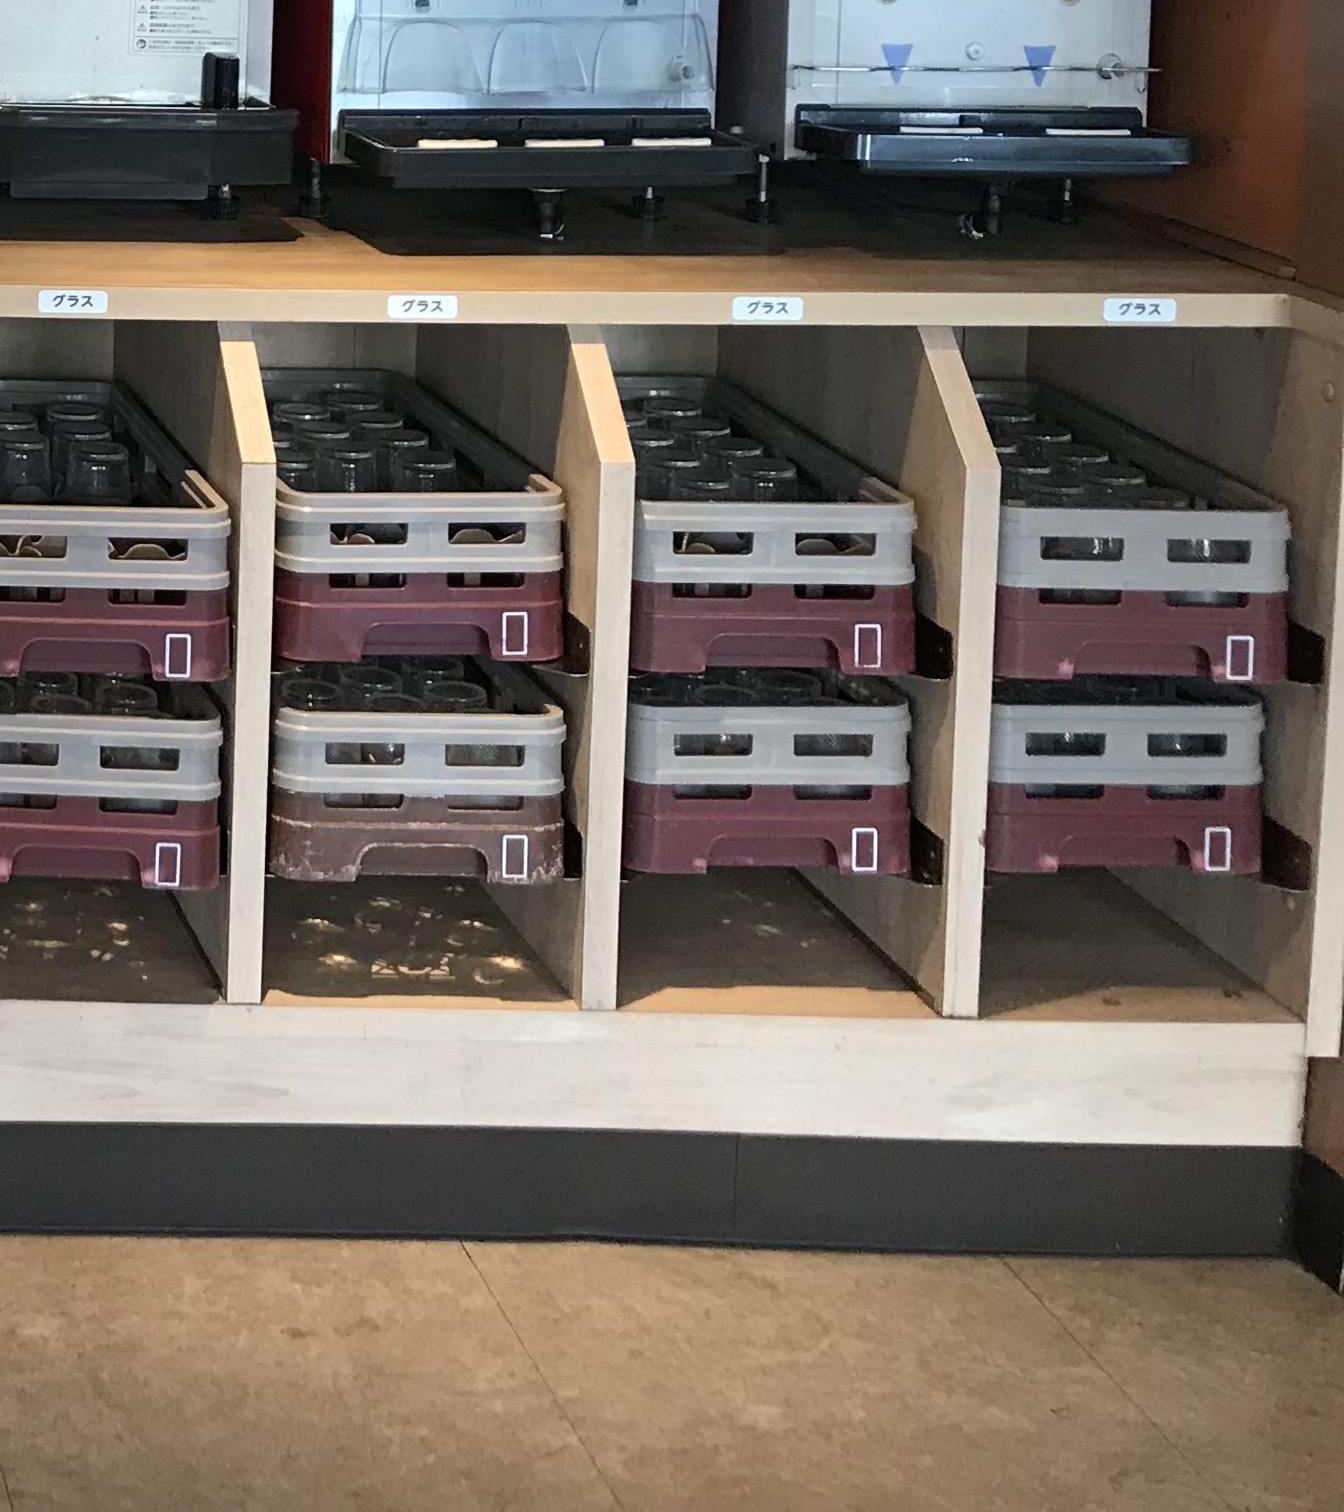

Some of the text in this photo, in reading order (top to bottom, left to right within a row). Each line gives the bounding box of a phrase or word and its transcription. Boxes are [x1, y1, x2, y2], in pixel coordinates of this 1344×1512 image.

[52, 294, 94, 308] グラス
[402, 299, 443, 313] グラス
[747, 300, 789, 315] グラス
[1119, 302, 1161, 316] グラス
